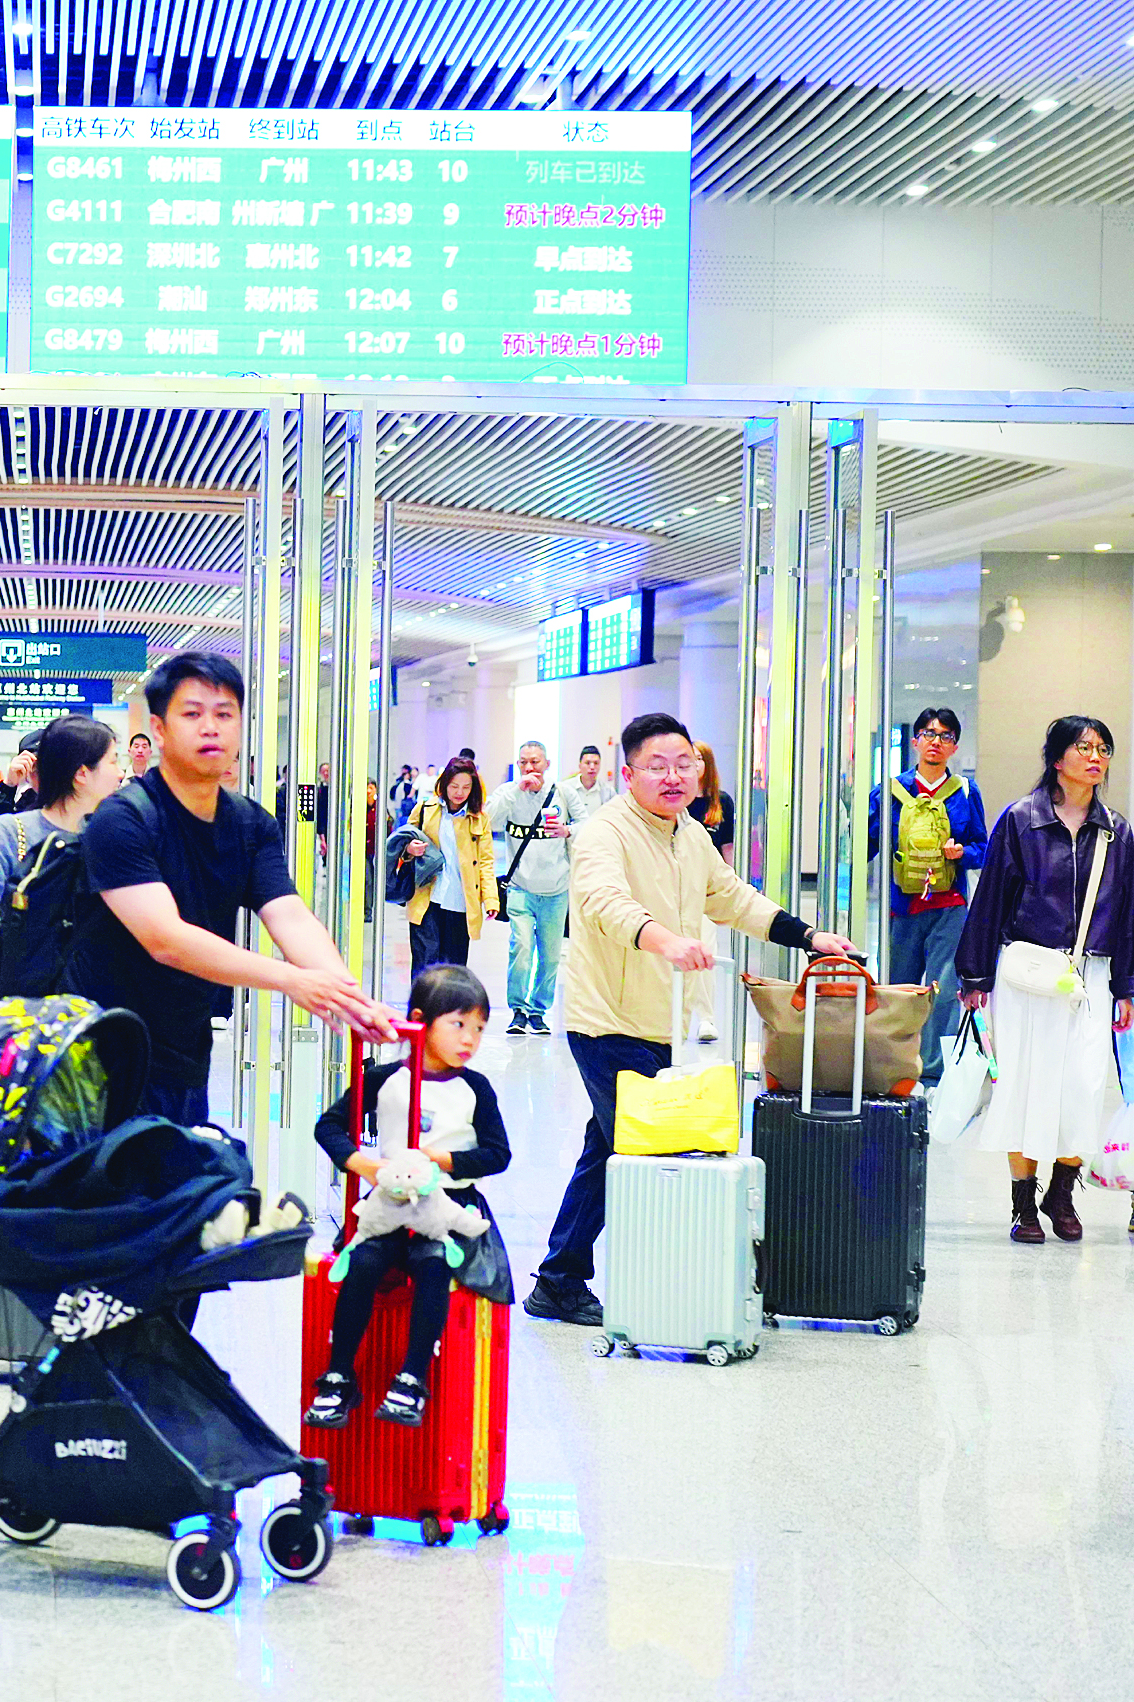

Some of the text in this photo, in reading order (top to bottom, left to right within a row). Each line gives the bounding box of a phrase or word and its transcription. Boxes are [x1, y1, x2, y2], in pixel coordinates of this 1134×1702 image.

[42, 116, 609, 142] 高铁车次 始发站 终到站 到点 站台 状态
[48, 157, 121, 178] G8461
[260, 157, 307, 182] 广州
[348, 159, 412, 181] 11:43
[439, 160, 467, 181] 10
[526, 160, 644, 184] 列车已到达
[47, 200, 121, 221] G4111
[347, 202, 412, 224] 11:39
[444, 203, 459, 224] 9
[505, 204, 665, 229] 预计晚点2分钟
[47, 243, 122, 264] C7292
[347, 245, 411, 267] 11:42
[444, 247, 458, 267] 7
[535, 246, 632, 272] 早点到达
[46, 286, 124, 307] G2694
[346, 289, 411, 310] 12:04
[443, 290, 457, 311] 6
[534, 289, 631, 315] 正点到达
[45, 329, 122, 350] G8479
[257, 330, 304, 355] 广州
[345, 332, 410, 353] 12:07
[436, 333, 464, 353] 10
[503, 333, 662, 358] 预计晚点1分钟
[26, 642, 61, 656] 出站口
